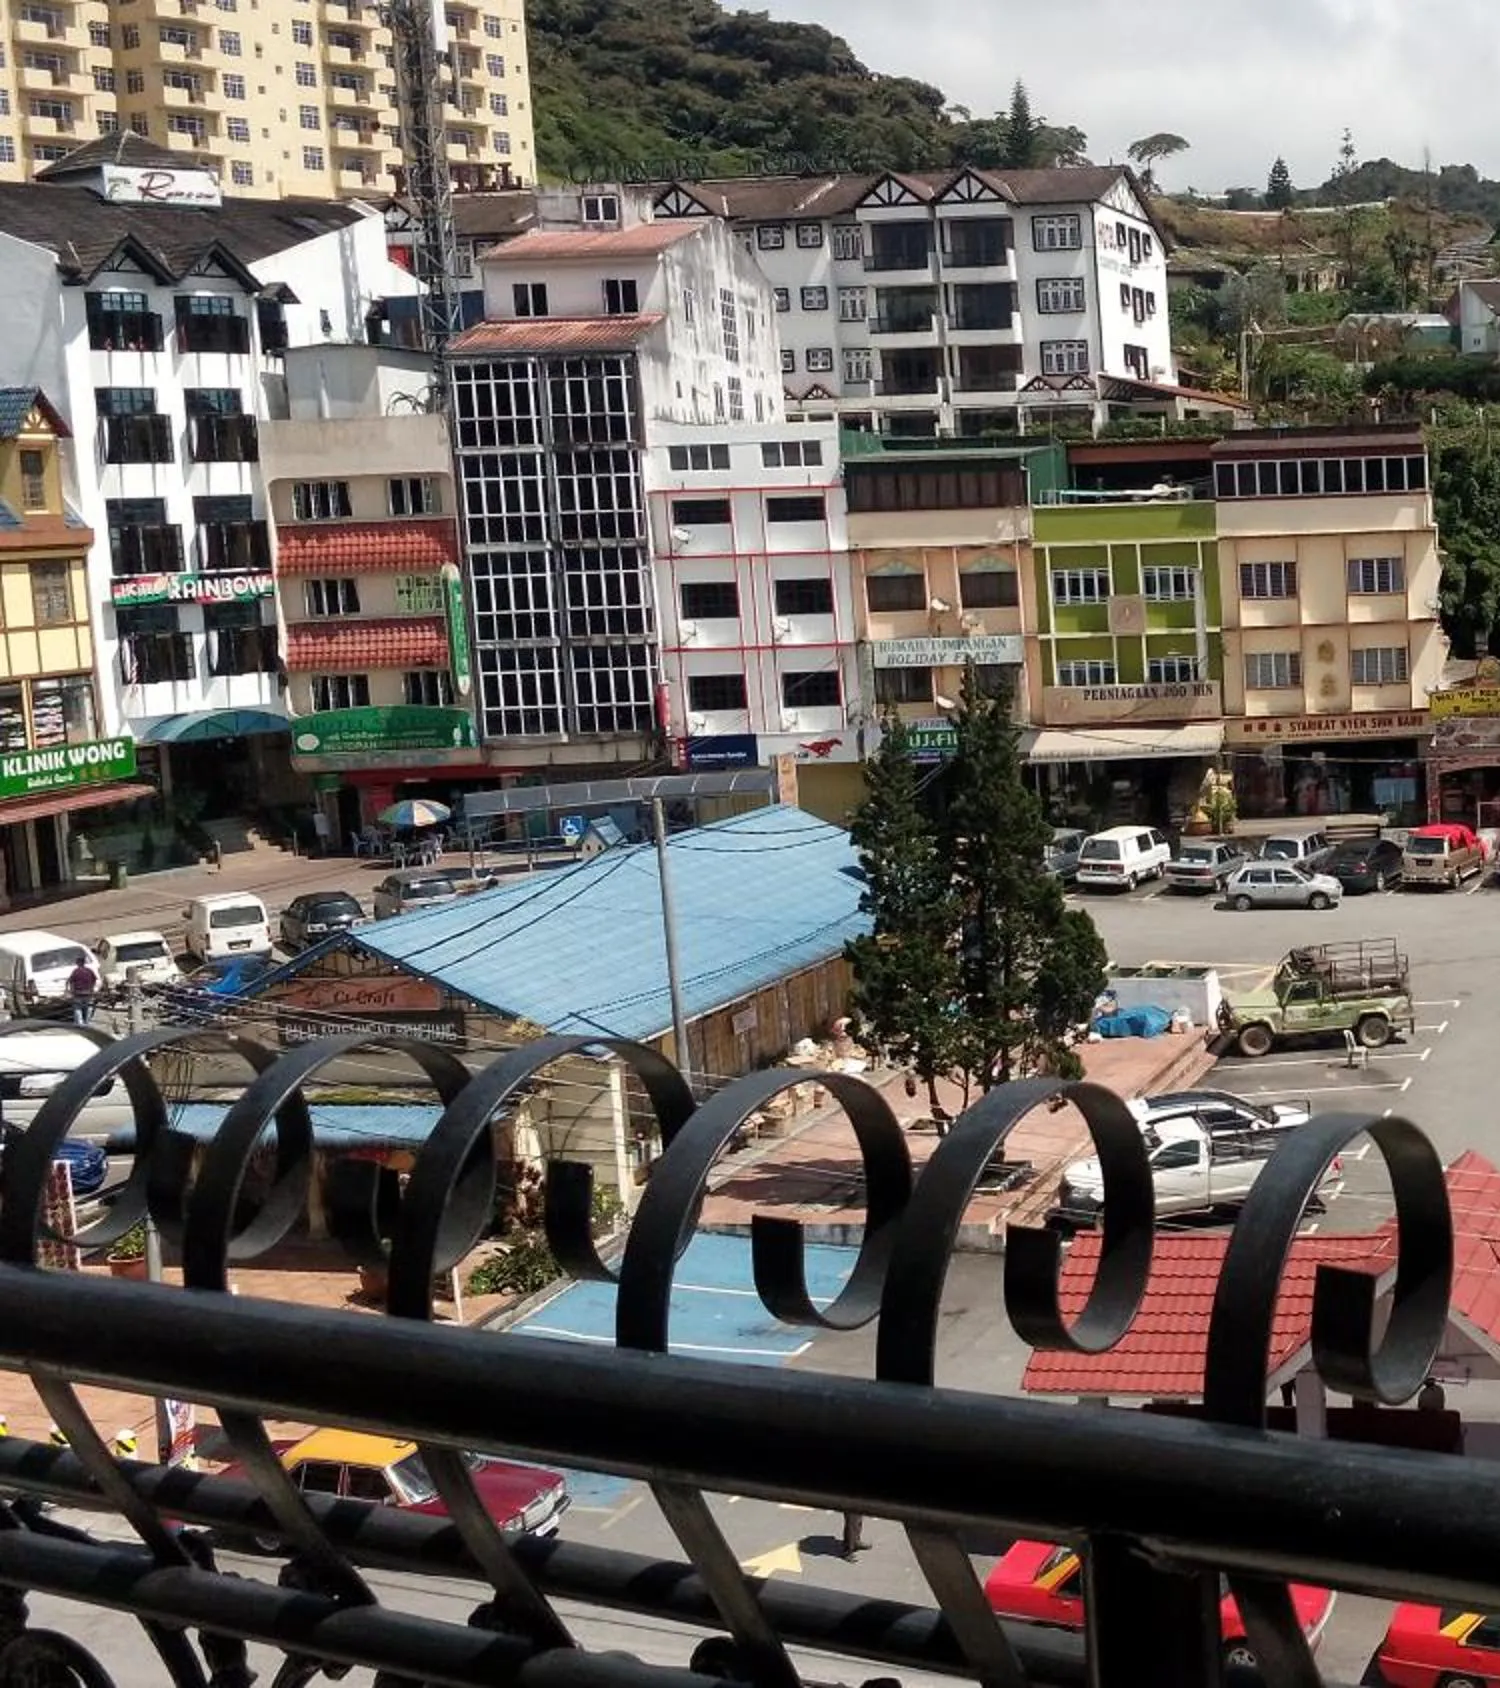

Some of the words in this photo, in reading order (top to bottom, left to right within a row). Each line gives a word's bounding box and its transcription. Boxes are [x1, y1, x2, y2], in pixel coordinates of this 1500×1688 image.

[168, 575, 267, 599] RAINBOW
[887, 652, 947, 665] HOLIDAY
[3, 750, 66, 778] KLINIK
[68, 741, 126, 766] WONG
